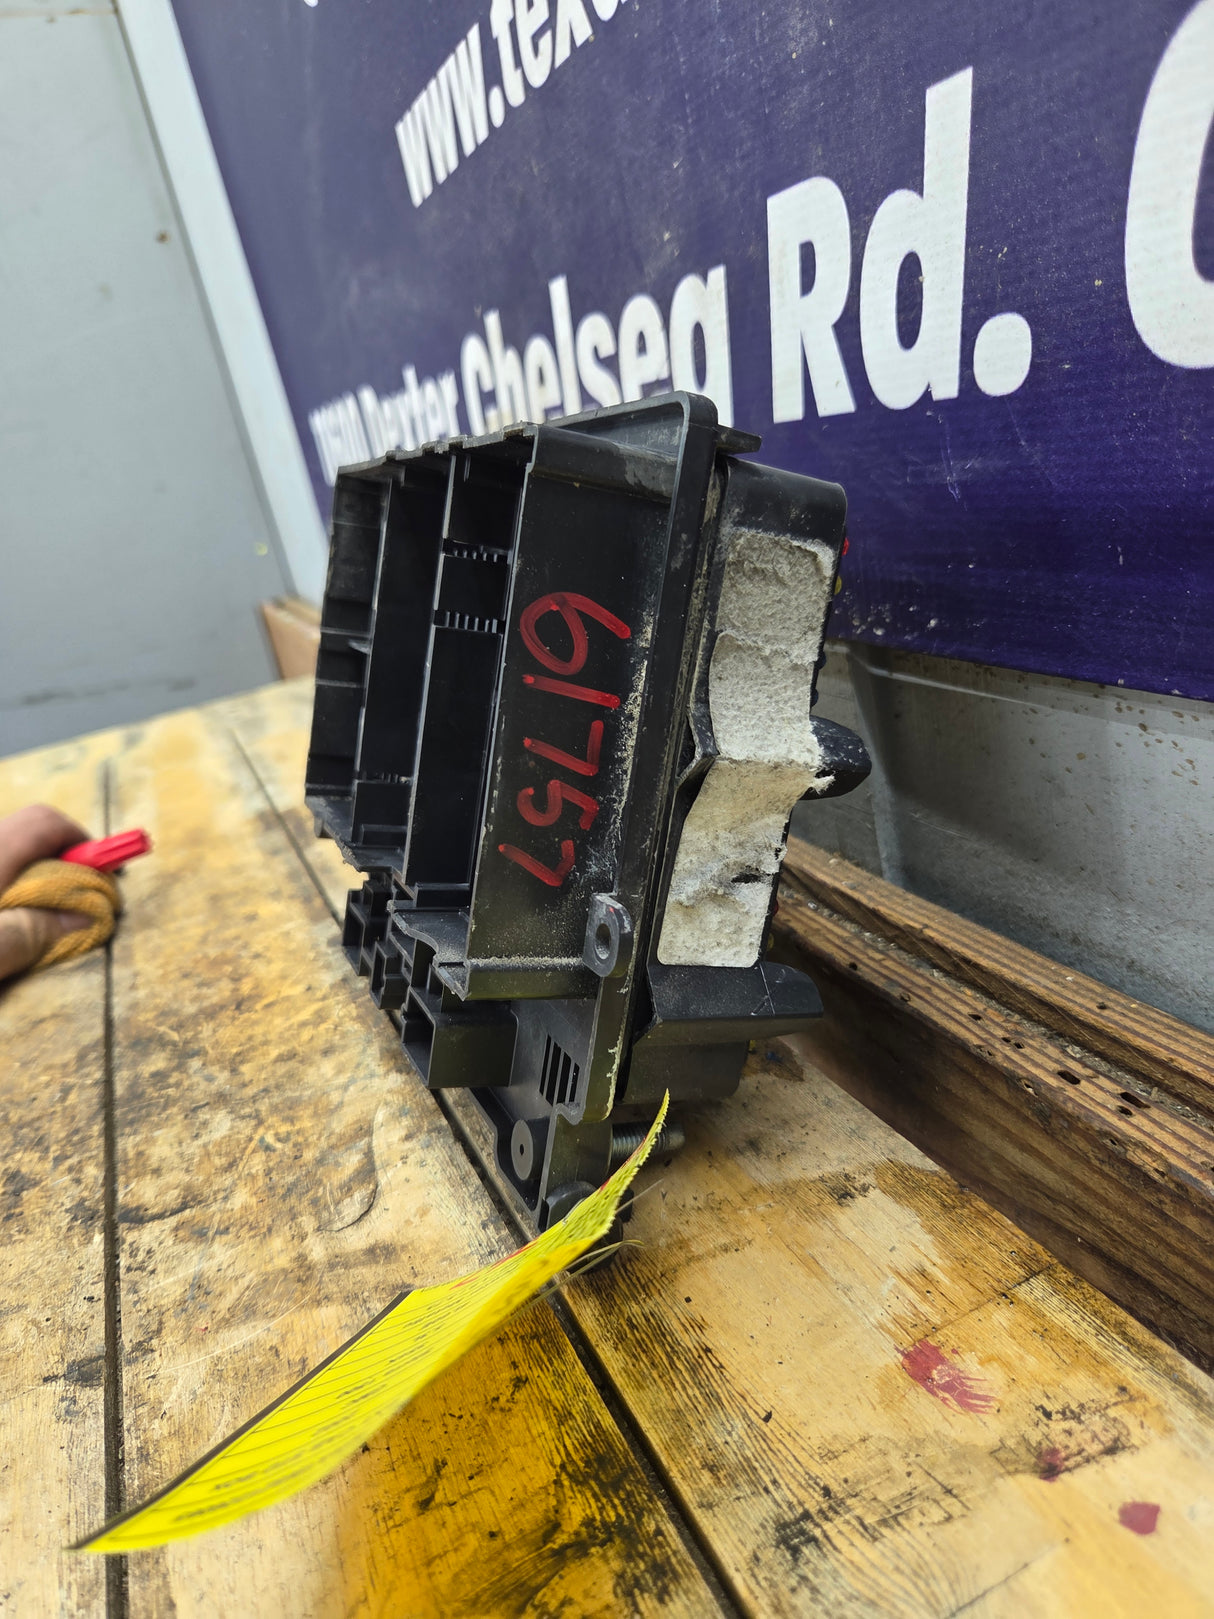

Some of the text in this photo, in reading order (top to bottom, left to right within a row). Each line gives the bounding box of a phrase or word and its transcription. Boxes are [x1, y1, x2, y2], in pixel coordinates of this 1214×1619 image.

[460, 264, 734, 438] Chelsea
[767, 66, 1032, 424] Rd.
[498, 591, 631, 887] 61757
